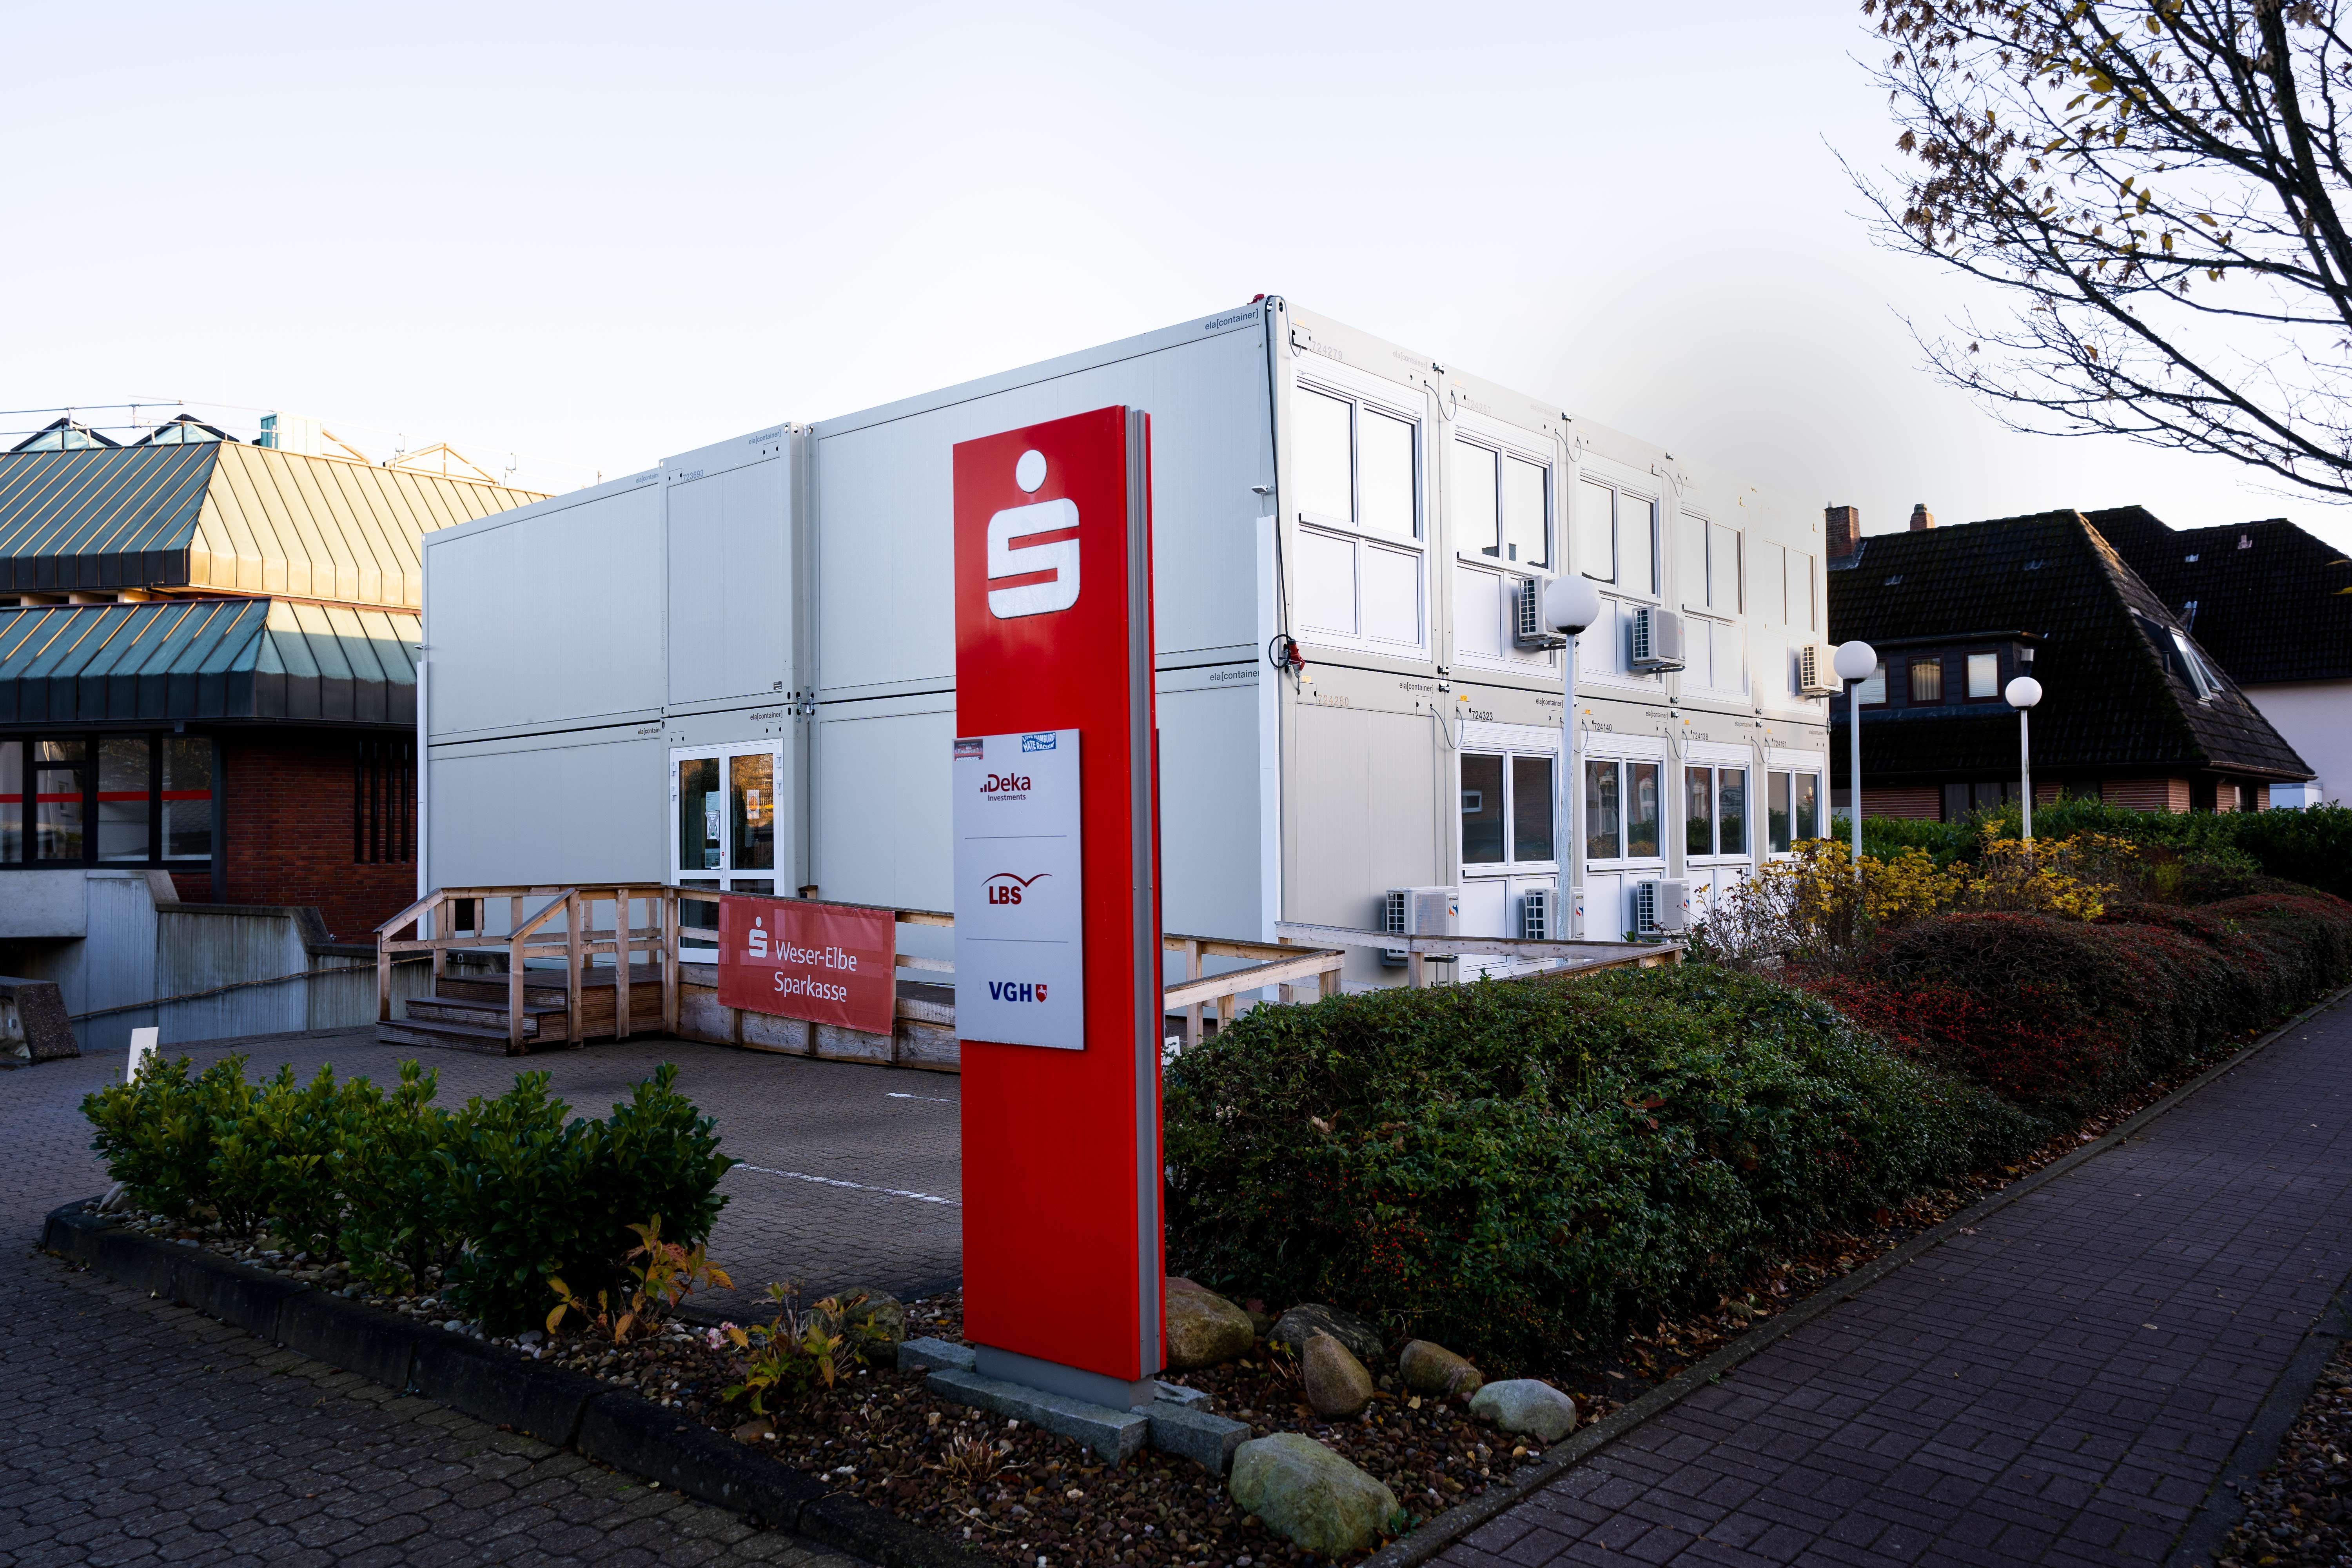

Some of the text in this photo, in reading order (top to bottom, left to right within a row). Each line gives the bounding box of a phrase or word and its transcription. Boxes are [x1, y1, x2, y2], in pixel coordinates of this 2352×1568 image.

[1205, 309, 1258, 330] ela[container]
[1312, 341, 1343, 360] 724279
[1393, 350, 1427, 371] ela[container]
[1467, 399, 1492, 414] 724257
[748, 430, 781, 445] ela[container]
[683, 469, 704, 482] 723693
[1399, 681, 1434, 693] ela[container]
[1318, 693, 1349, 707] 724280
[1536, 697, 1563, 708] ela[container]
[750, 711, 783, 721] ela[container]
[1472, 710, 1493, 721] 724323
[1646, 710, 1668, 720] ela[container]
[1594, 722, 1612, 732] 724140
[1033, 733, 1055, 743] HAMBURG
[1692, 732, 1708, 740] 724138
[1023, 740, 1036, 751] HATE
[988, 773, 1031, 792] Deka
[989, 886, 1022, 905] LBS
[775, 939, 857, 971] Weser-Elbe
[774, 971, 847, 1003] Sparkasse
[989, 981, 1032, 1002] VGH
